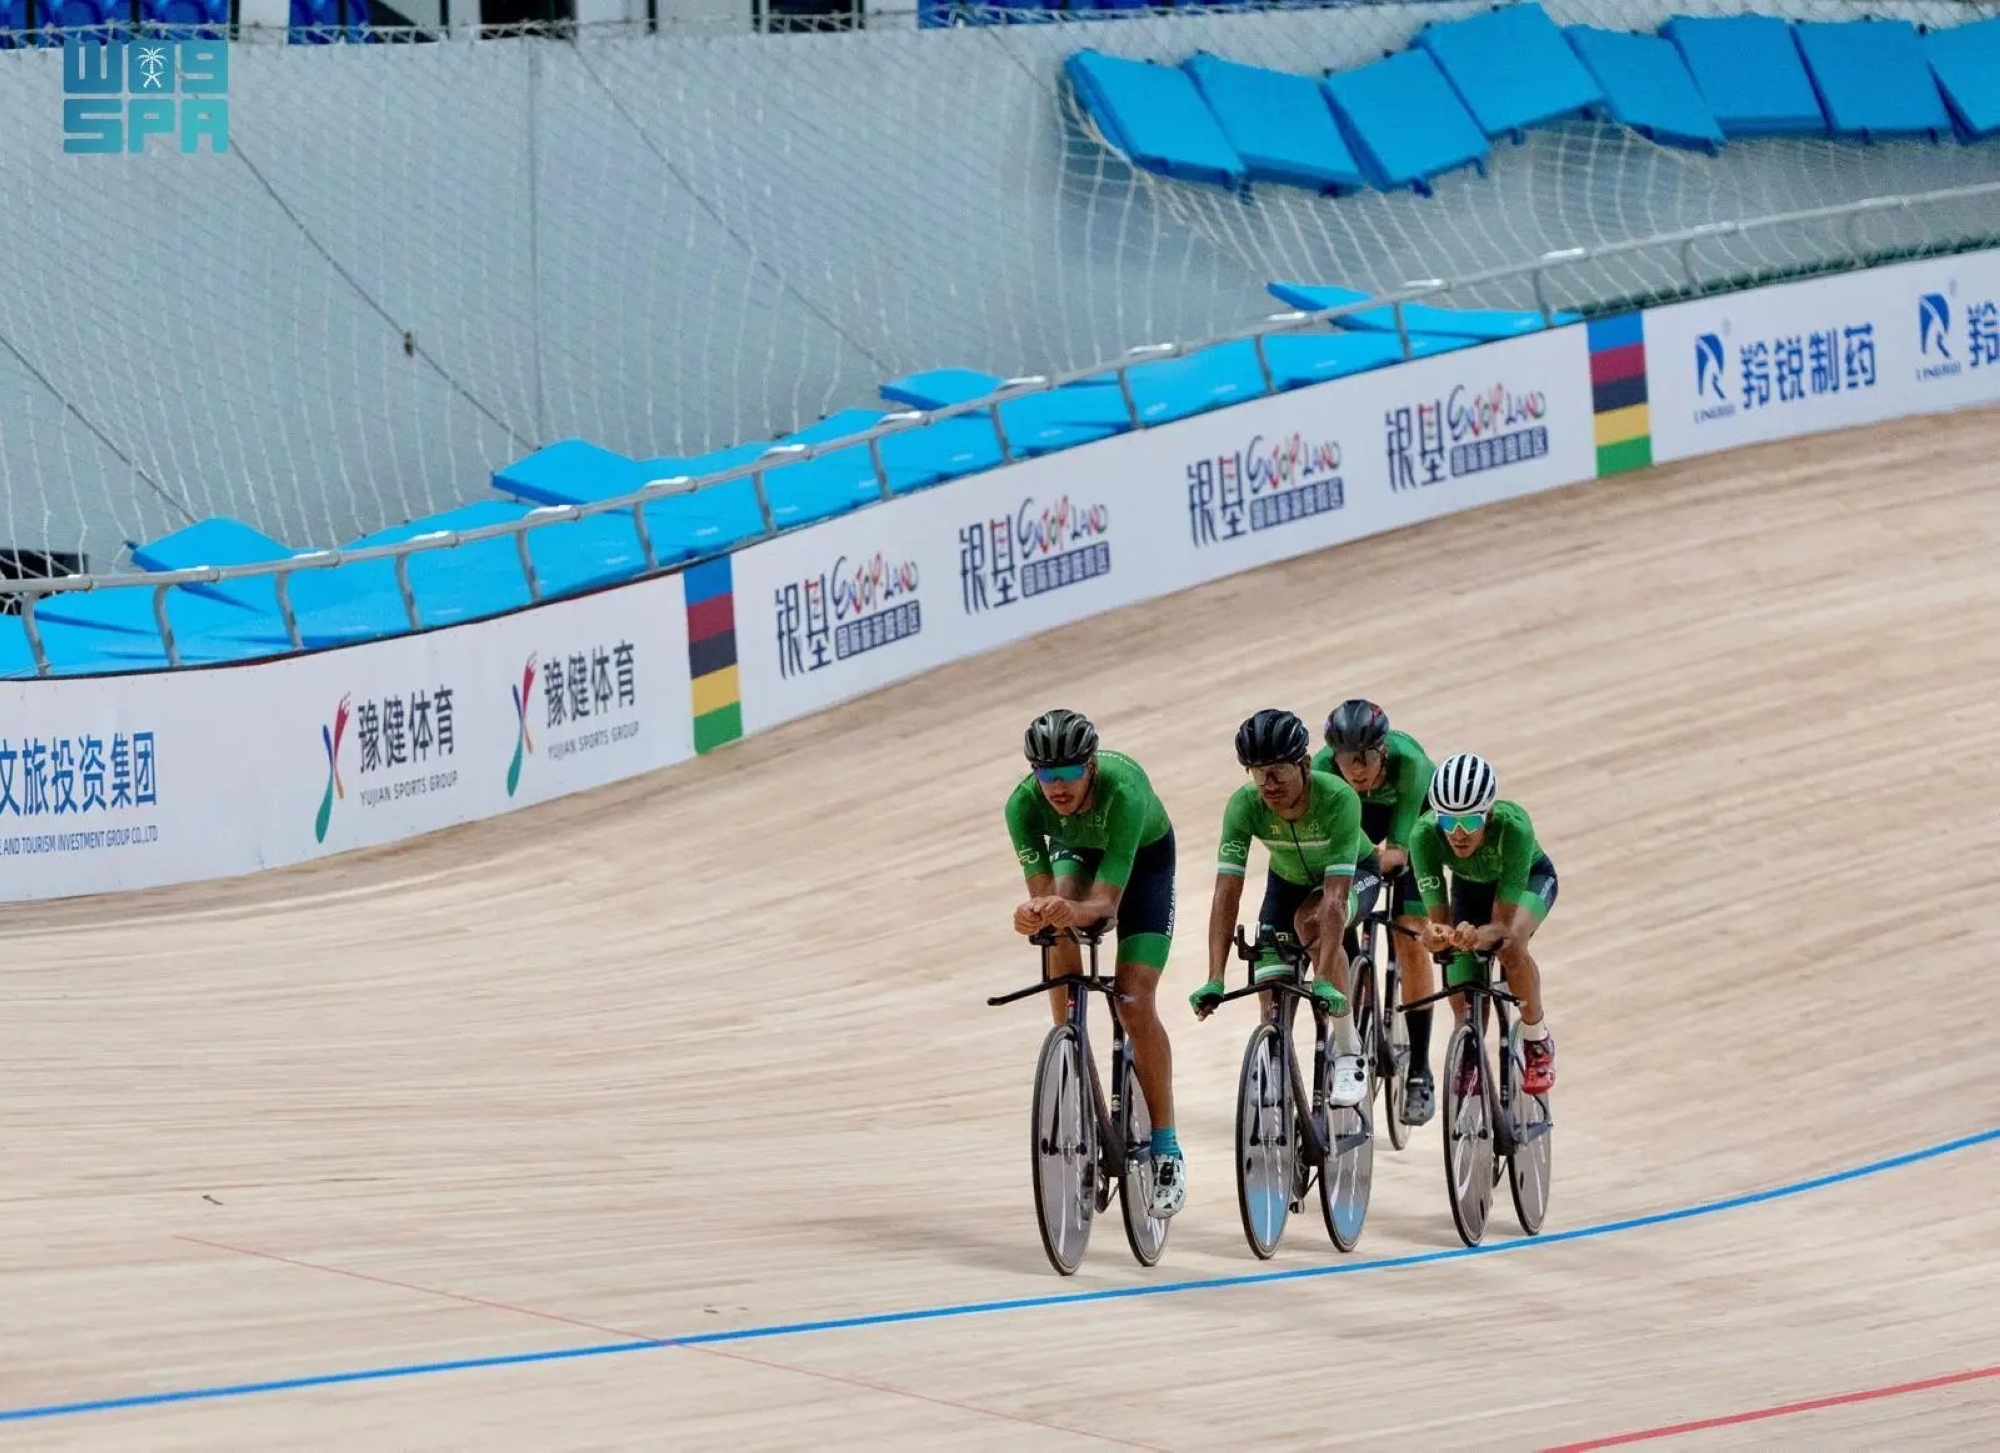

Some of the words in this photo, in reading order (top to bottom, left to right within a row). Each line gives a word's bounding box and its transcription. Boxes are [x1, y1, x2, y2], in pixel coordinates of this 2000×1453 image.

[1740, 322, 1876, 409] 羚锐制药
[544, 639, 636, 729] 豫健体育
[358, 684, 455, 774] 豫健体育
[578, 729, 609, 752] SPORTS
[611, 720, 639, 743] GROUP
[0, 731, 157, 816] 文旅投资集团
[360, 786, 391, 808] YUJIAN
[393, 777, 427, 800] SPORTS
[430, 769, 458, 792] GROUP
[4, 838, 20, 856] AND
[21, 833, 56, 855] TOURISM
[57, 828, 105, 851] INVESTMENT
[106, 828, 130, 847] GROUP
